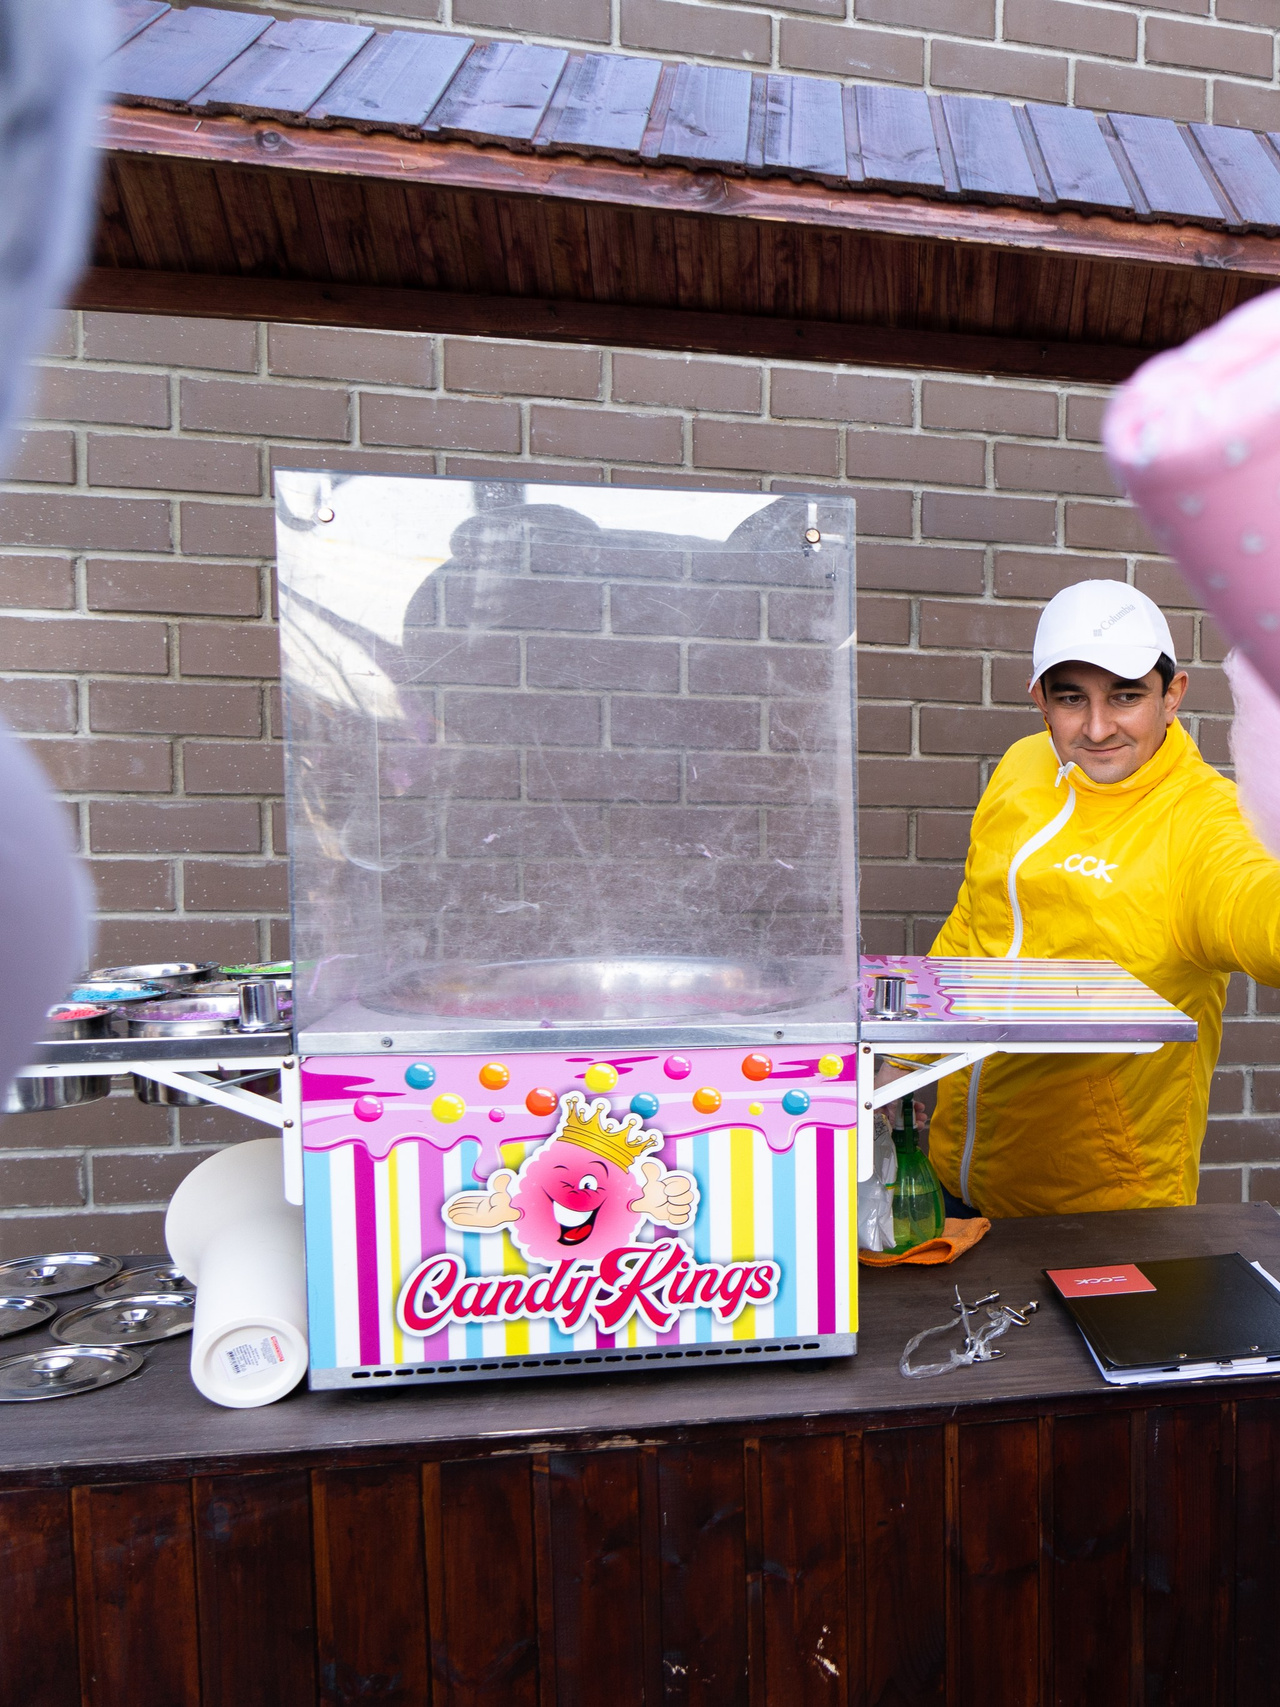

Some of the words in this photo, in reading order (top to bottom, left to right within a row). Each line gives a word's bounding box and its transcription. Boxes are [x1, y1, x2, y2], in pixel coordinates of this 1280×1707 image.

[1100, 604, 1136, 630] Columbia
[403, 1257, 599, 1332] Candy
[594, 1242, 775, 1330] Kings
